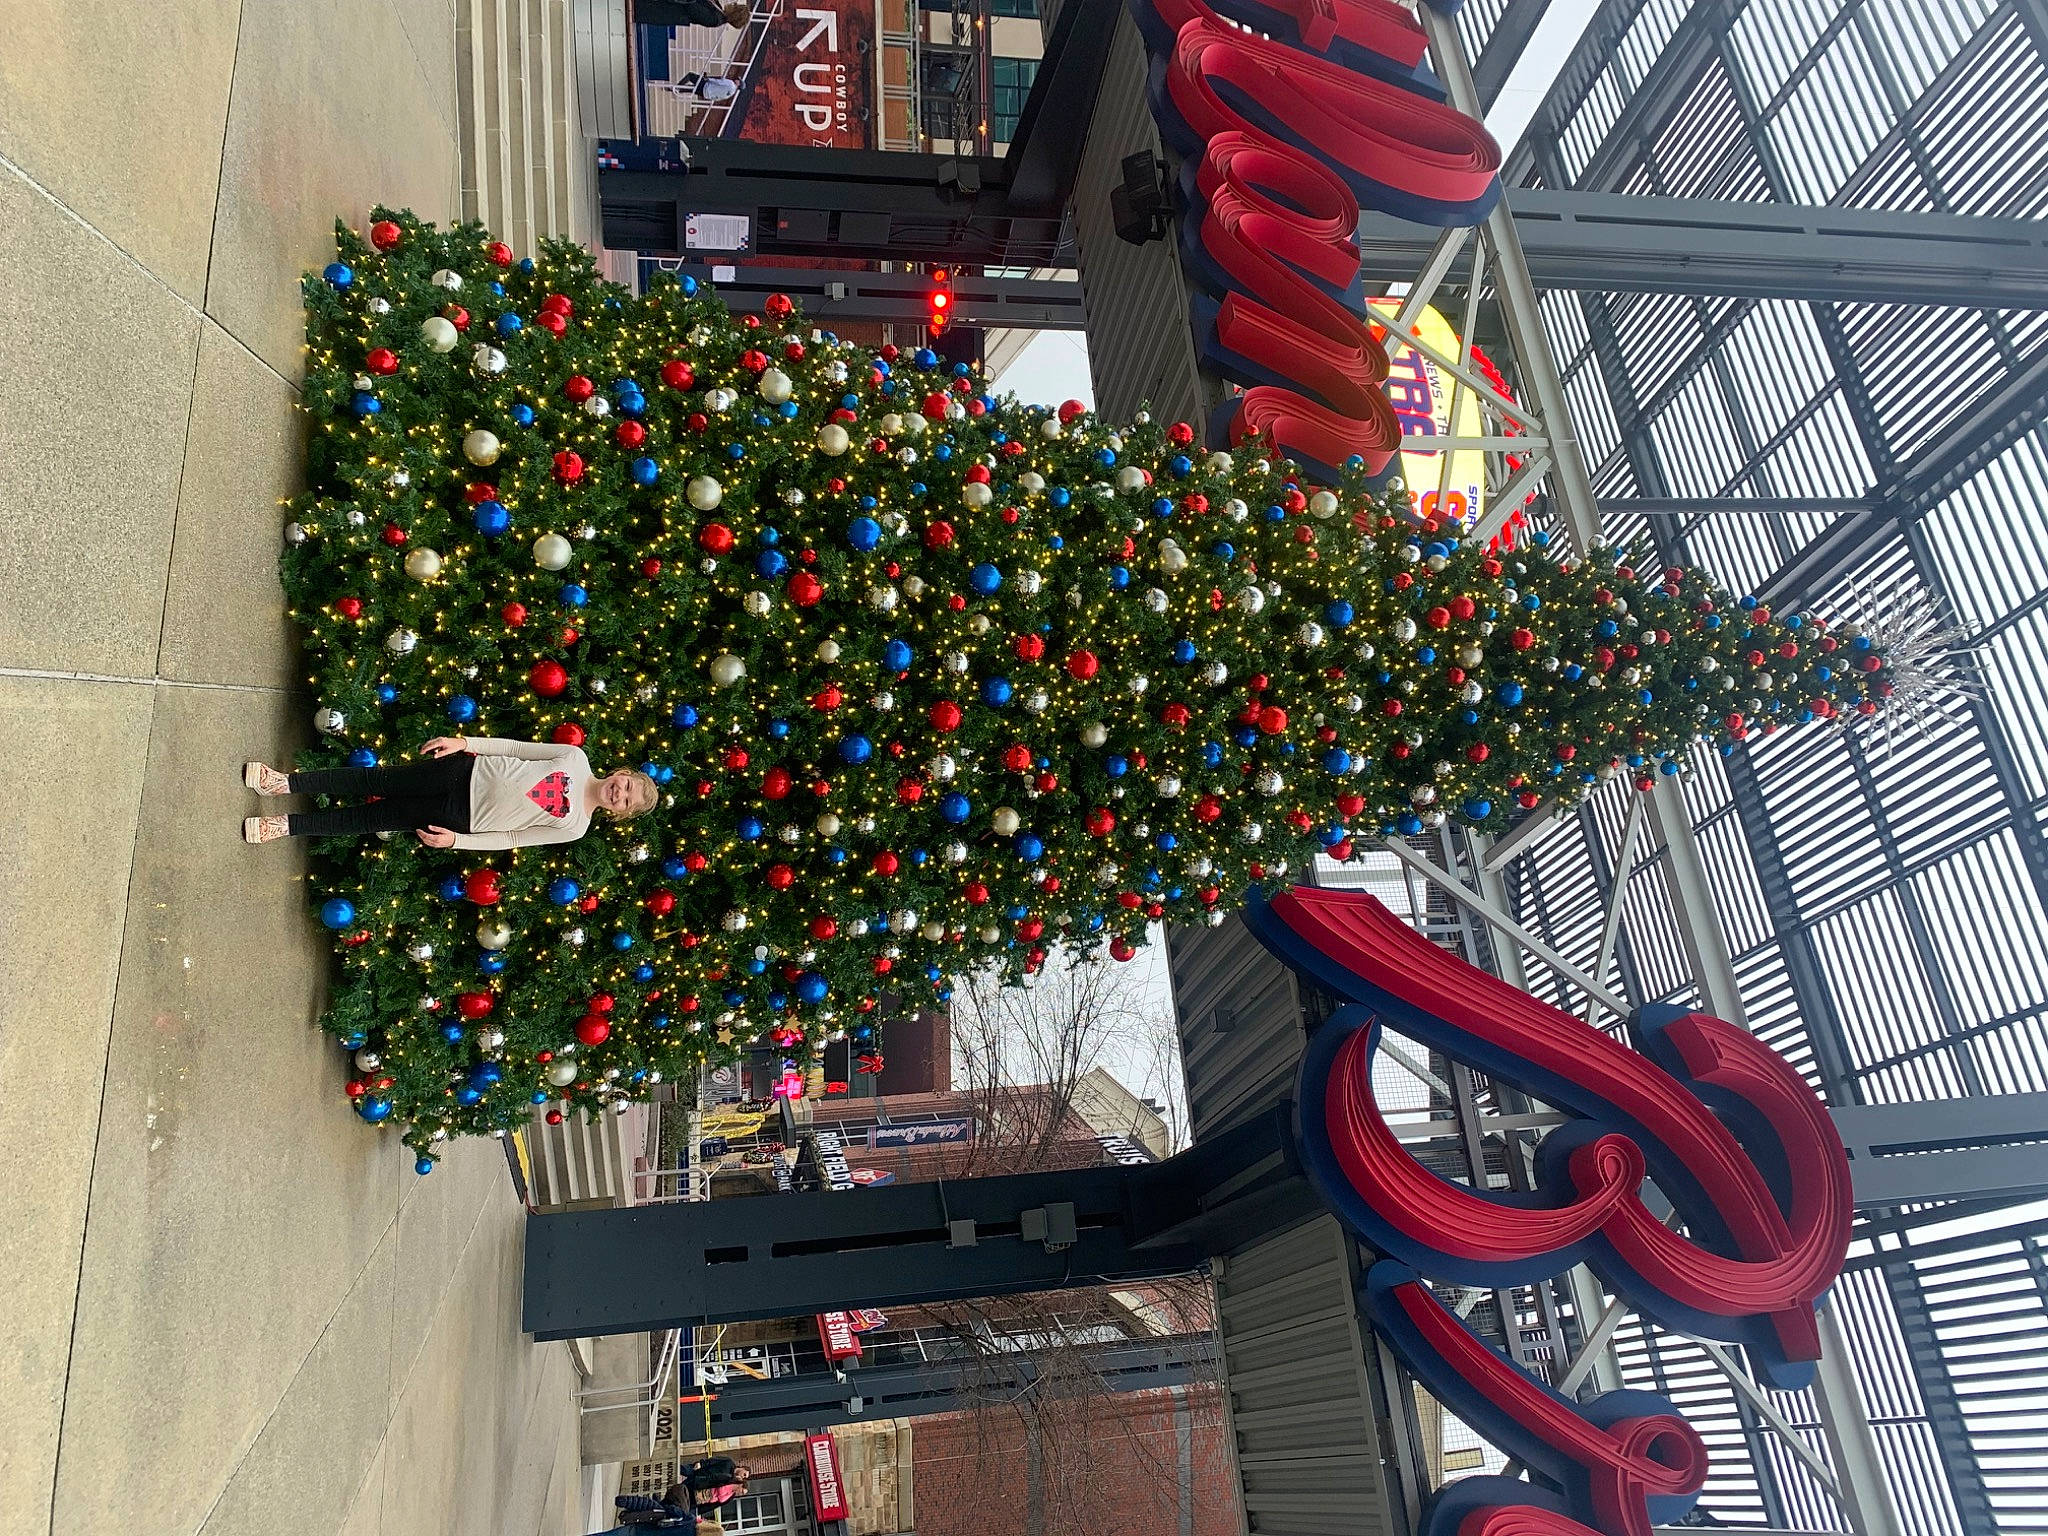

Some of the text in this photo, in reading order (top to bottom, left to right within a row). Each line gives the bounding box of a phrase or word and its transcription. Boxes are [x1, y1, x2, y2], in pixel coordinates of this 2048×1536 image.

[793, 63, 832, 131] UP
[835, 64, 847, 132] COWBOY
[1467, 485, 1478, 531] SPOR
[816, 1131, 843, 1155] RIGHT
[824, 1157, 852, 1180] FIELD
[656, 1409, 673, 1440] 2021
